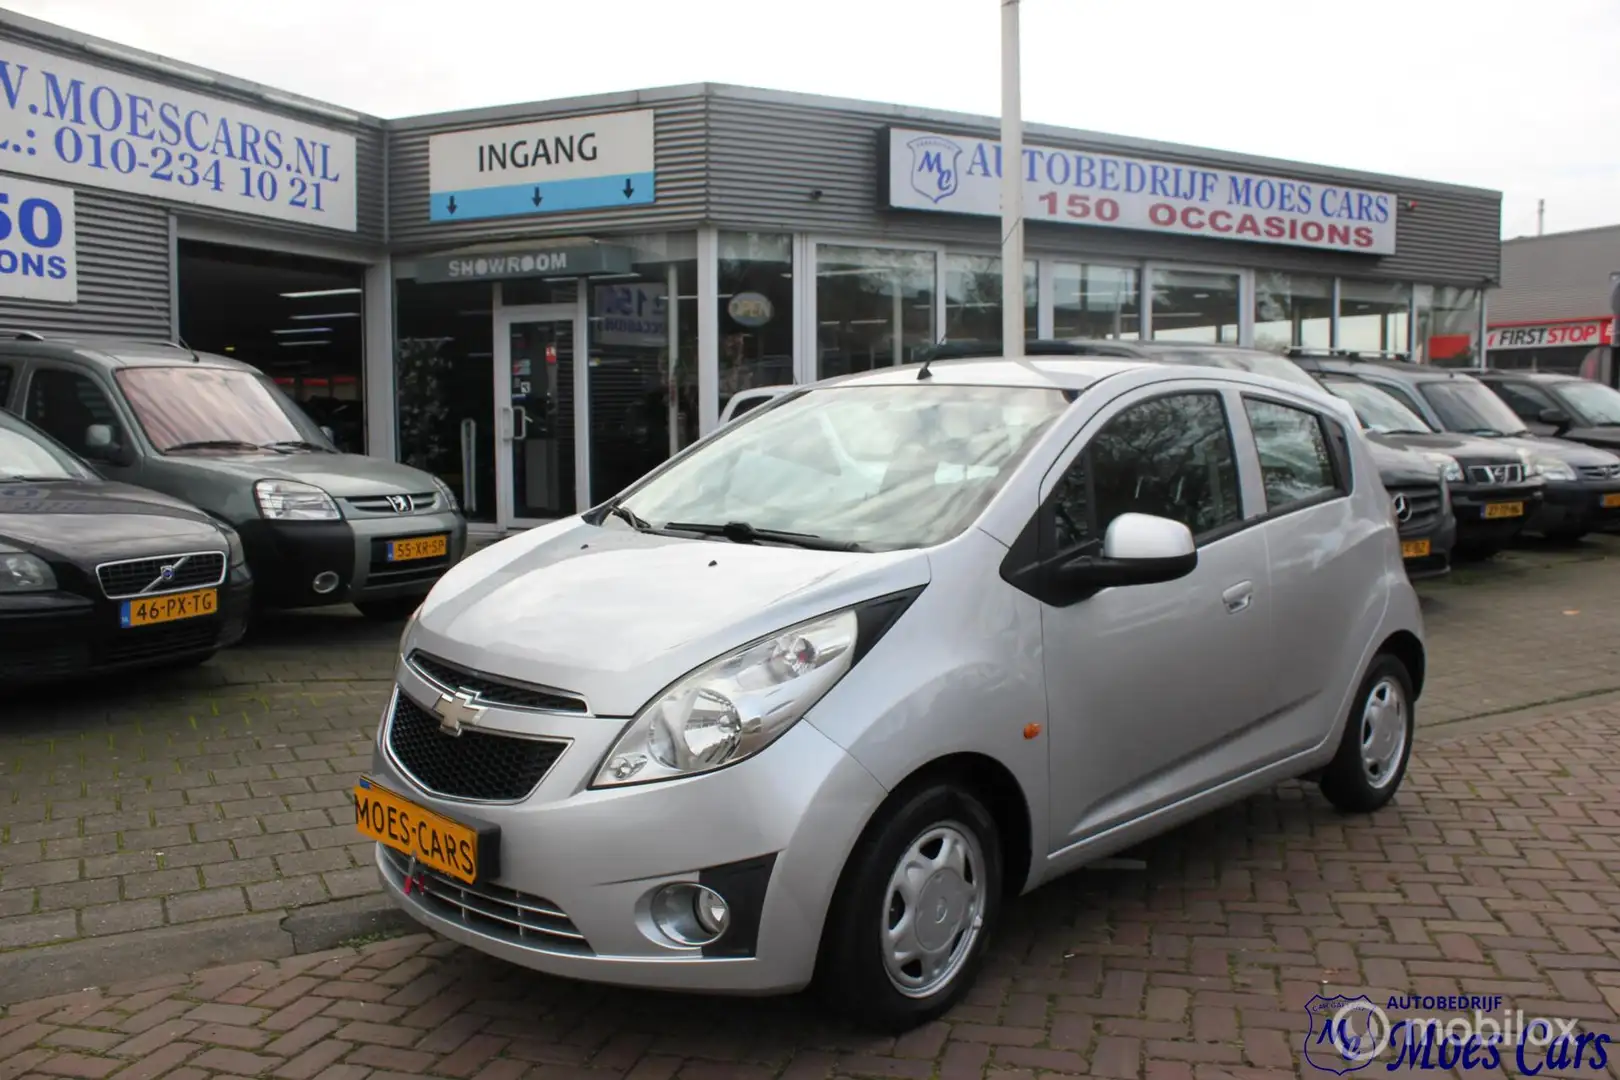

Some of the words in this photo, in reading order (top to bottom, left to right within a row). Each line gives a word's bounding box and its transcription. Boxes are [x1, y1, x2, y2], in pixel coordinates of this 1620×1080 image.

[54, 126, 225, 192] 010-234
[240, 166, 277, 201] 10
[289, 177, 325, 212] 21
[479, 132, 597, 172] INGANG
[1038, 191, 1120, 222] 150
[1148, 203, 1374, 248] OCCASIONS
[1228, 175, 1312, 215] MOES
[1320, 188, 1389, 224] CARS
[448, 252, 567, 277] SHOWROOM
[136, 593, 212, 620] 46-PX-TG
[354, 793, 474, 875] MOES-CARS
